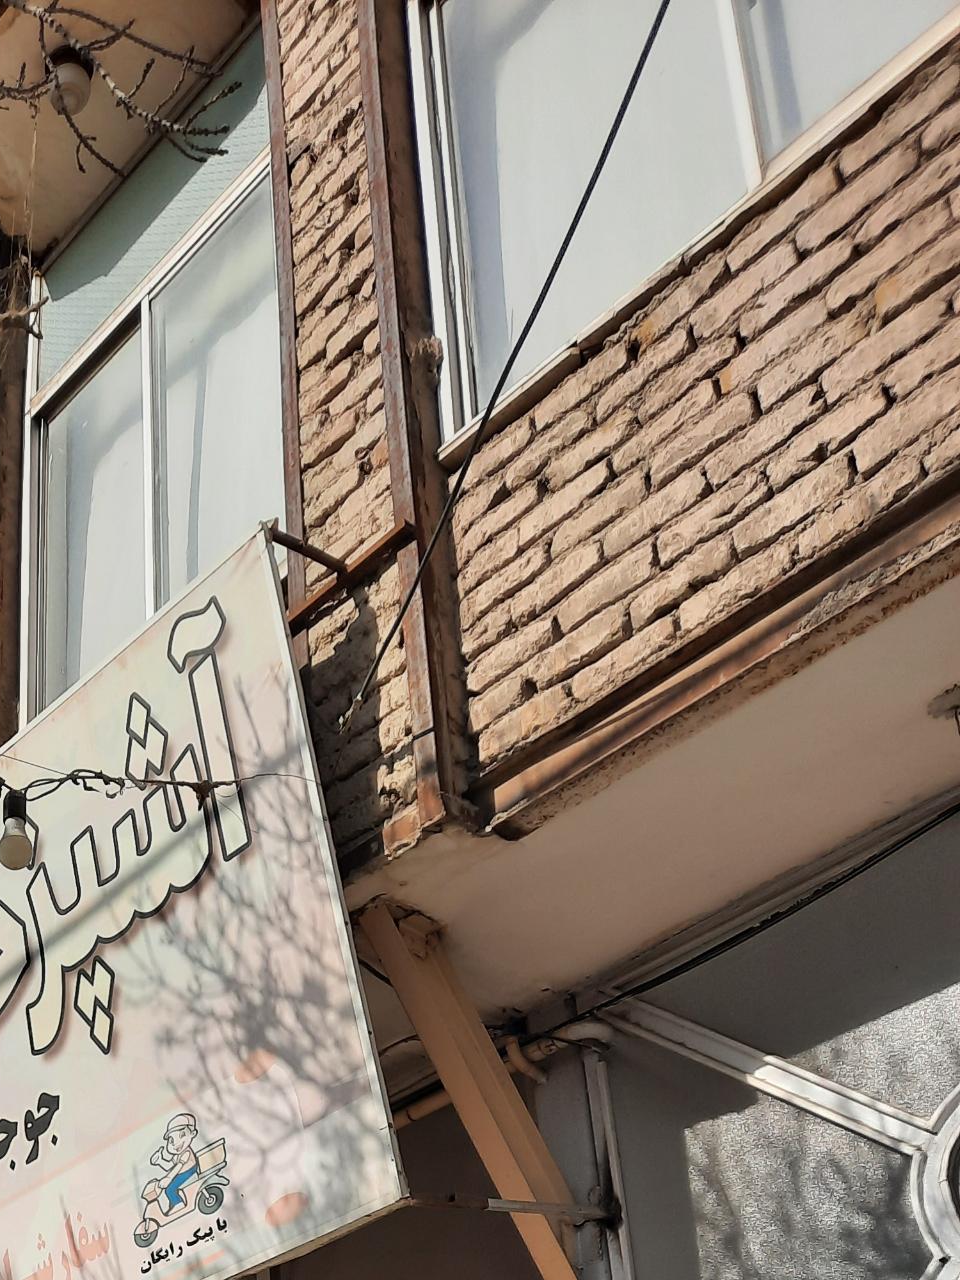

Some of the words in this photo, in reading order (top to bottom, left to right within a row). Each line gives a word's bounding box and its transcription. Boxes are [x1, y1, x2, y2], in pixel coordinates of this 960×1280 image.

[216, 1217, 228, 1234] با
[186, 1226, 215, 1247] پیک
[140, 1241, 184, 1275] رایگان
